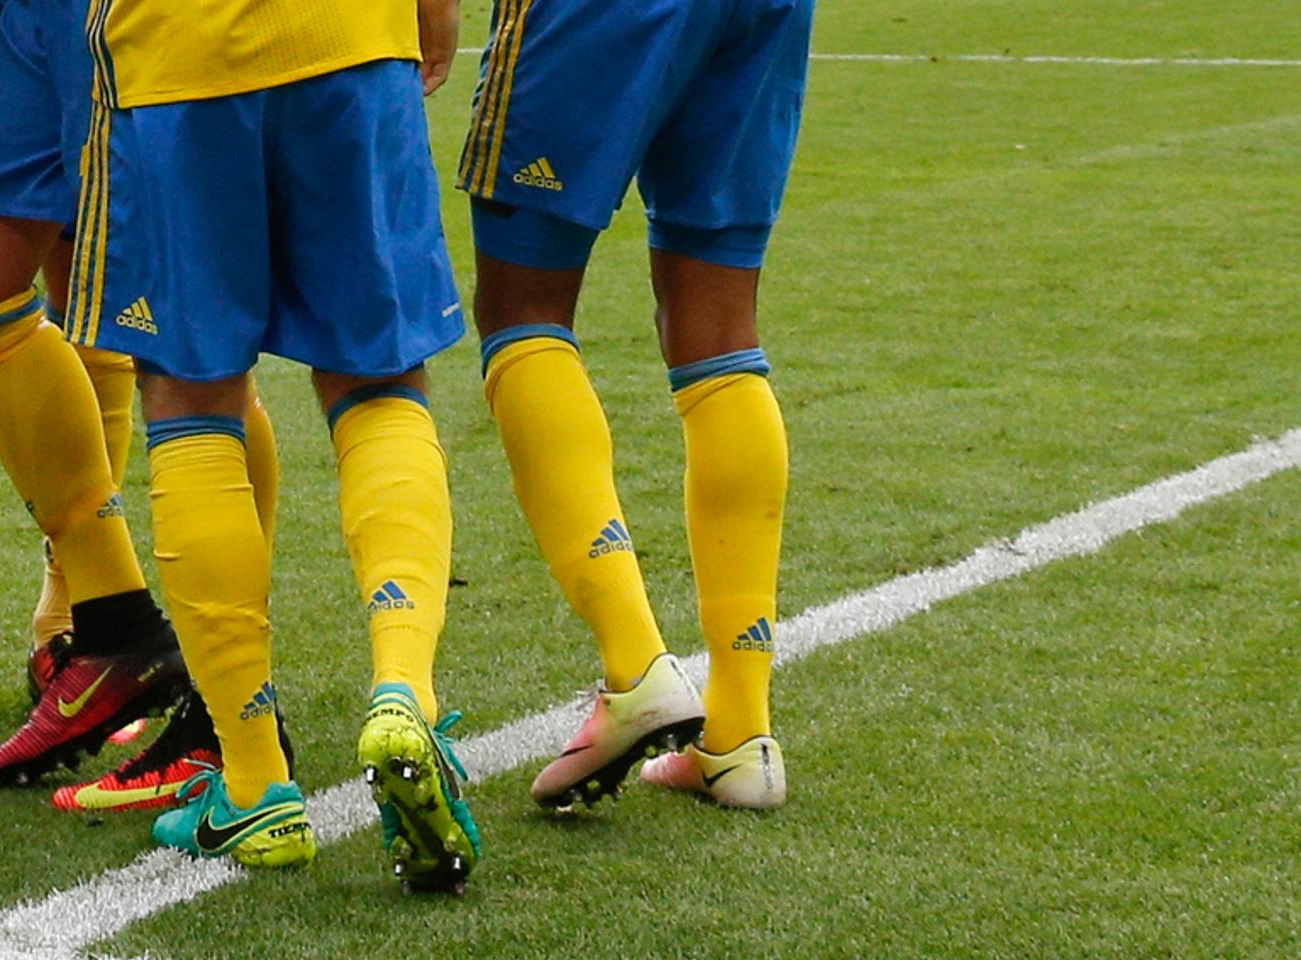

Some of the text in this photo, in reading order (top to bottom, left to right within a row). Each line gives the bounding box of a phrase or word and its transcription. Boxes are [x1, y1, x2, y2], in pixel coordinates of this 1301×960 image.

[513, 173, 563, 192] adidas
[116, 314, 158, 336] adidas
[268, 822, 312, 838] TIEMP
